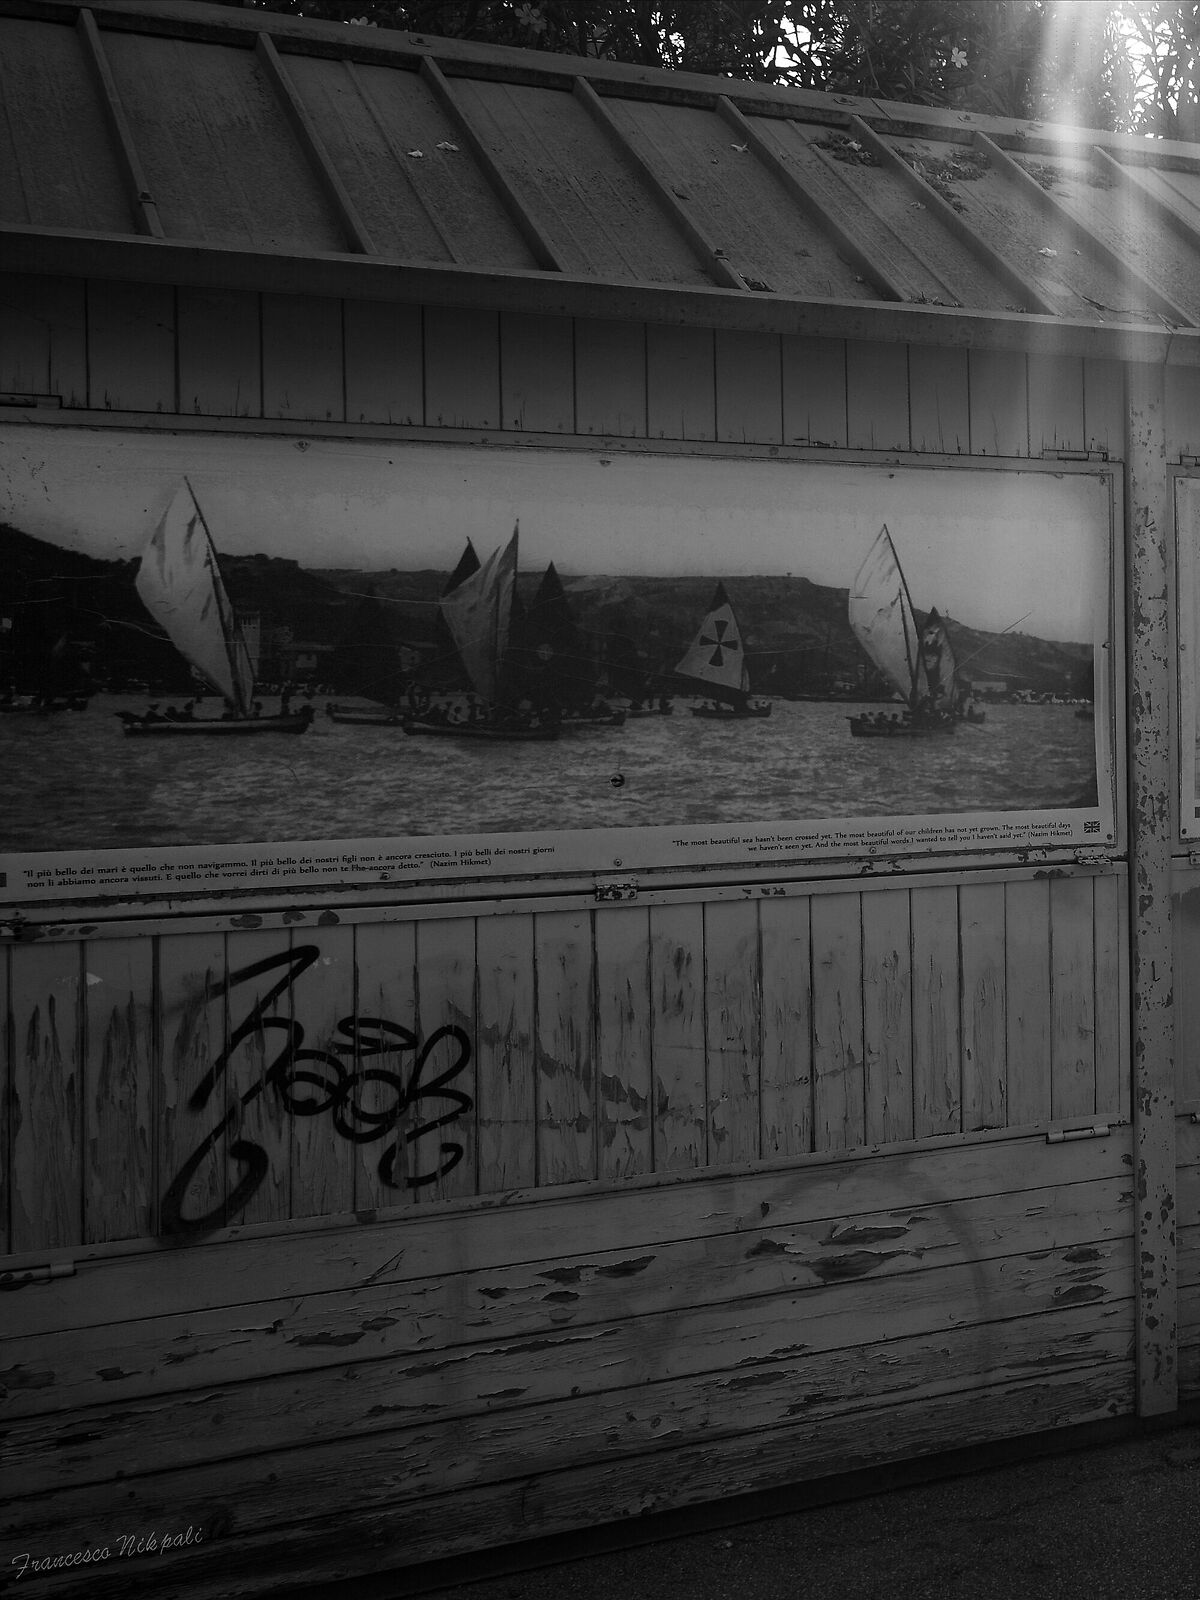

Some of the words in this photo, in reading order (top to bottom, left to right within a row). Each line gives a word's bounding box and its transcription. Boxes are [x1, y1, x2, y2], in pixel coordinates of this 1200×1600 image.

[710, 836, 740, 845] beautiful
[755, 834, 775, 843] hasn't
[777, 833, 793, 842] been
[795, 832, 819, 841] crossed
[821, 832, 833, 842] yet.
[835, 831, 847, 839] The
[867, 829, 895, 838] beautiful
[896, 828, 903, 836] of
[918, 826, 943, 835] children
[944, 826, 955, 834] has
[969, 826, 978, 835] yet
[980, 825, 1000, 834] grown.
[1002, 823, 1014, 831] The
[1015, 823, 1030, 831] most
[1031, 821, 1057, 830] beautiful
[1058, 820, 1071, 831] days
[759, 842, 783, 851] haven't
[801, 841, 814, 851] yet.
[816, 840, 829, 848] And
[830, 839, 842, 848] the
[843, 839, 859, 847] most
[861, 837, 889, 846] beautiful
[916, 834, 938, 843] wanted
[948, 833, 958, 842] tell
[959, 834, 971, 843] you
[976, 832, 998, 840] haven't
[999, 831, 1011, 839] said
[1012, 830, 1026, 840] yet."
[1028, 829, 1049, 840] (Nazim
[1050, 828, 1073, 839] Hikmet)
[37, 868, 52, 879] più
[55, 867, 78, 877] bello
[80, 866, 94, 876] dei
[97, 865, 118, 875] mari
[130, 863, 157, 875] quello
[160, 862, 175, 872] che
[178, 863, 195, 871] non
[198, 859, 248, 872] navigammo.
[251, 859, 257, 867] Il
[260, 858, 274, 869] più
[276, 857, 297, 866] bello
[299, 856, 312, 865] dei
[315, 855, 339, 864] nostri
[342, 854, 357, 865] figli
[386, 853, 412, 861] ancora
[414, 849, 451, 860] cresciuto.
[460, 848, 473, 859] più
[475, 847, 492, 857] belli
[494, 847, 506, 856] dei
[508, 845, 531, 855] nostri
[532, 844, 555, 856] giorni
[48, 878, 54, 887] li
[58, 876, 96, 887] abbiamo
[99, 876, 129, 885] ancora
[132, 873, 163, 883] vissuti.
[175, 871, 202, 883] quello
[204, 870, 219, 879] che
[222, 869, 248, 879] vorrei
[250, 868, 269, 877] dirti
[271, 867, 280, 876] di
[282, 866, 297, 877] più
[299, 865, 320, 875] bello
[322, 866, 338, 874] non
[341, 865, 349, 873] te
[369, 863, 396, 871] ancora
[398, 860, 424, 870] detto."
[430, 858, 458, 870] (Nazim
[460, 857, 492, 869] Hikmet)
